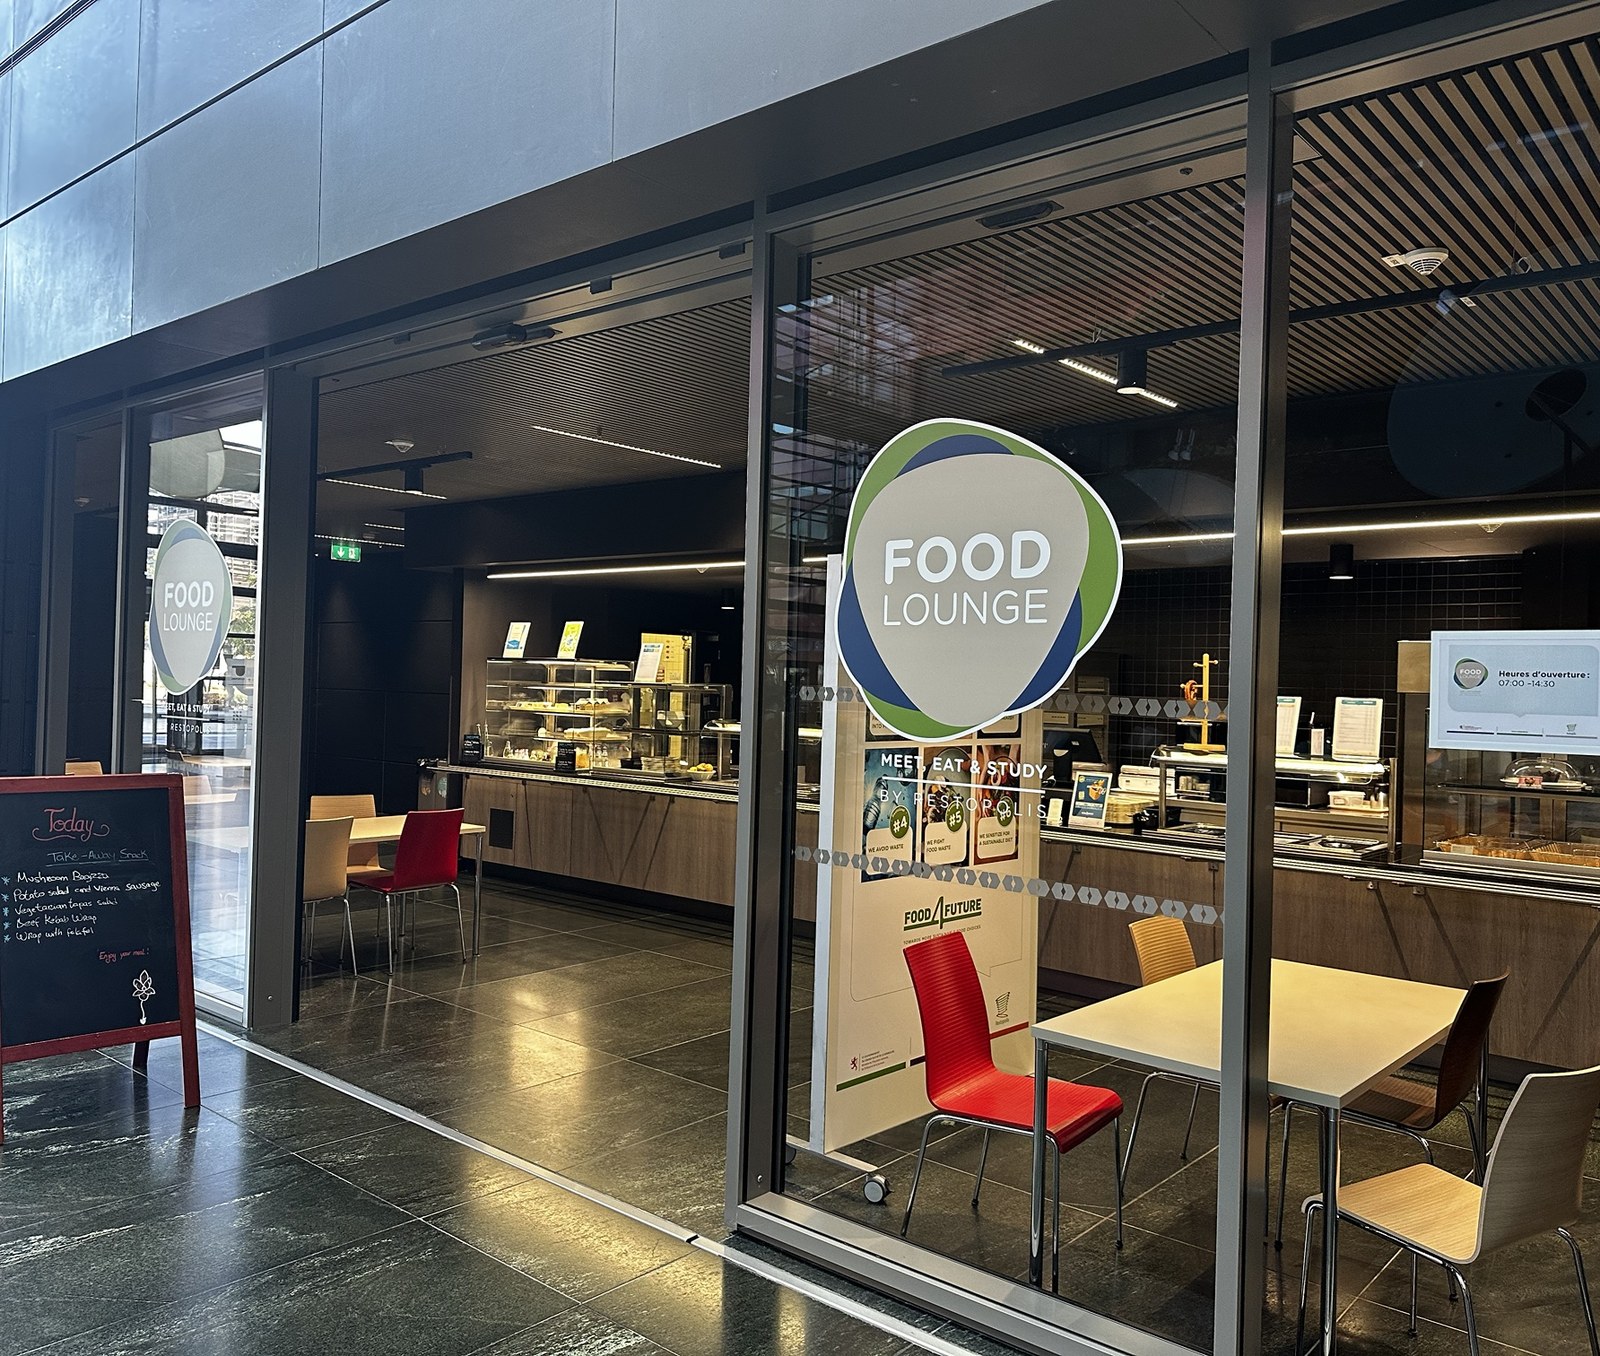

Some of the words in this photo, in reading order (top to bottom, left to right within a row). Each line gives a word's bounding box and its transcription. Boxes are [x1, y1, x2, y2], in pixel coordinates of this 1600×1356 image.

[884, 530, 1051, 585] FOOD
[164, 581, 214, 608] FOOD
[883, 589, 1049, 626] LOUNGE
[163, 612, 213, 631] LOUNGE
[176, 703, 187, 712] EAT
[188, 704, 192, 712] &
[881, 753, 926, 773] MEET,
[932, 757, 964, 773] EAT
[970, 760, 980, 775] &
[987, 760, 1047, 779] STUDY
[880, 789, 902, 803] BY
[913, 792, 1048, 819] RESTOPOLIS
[44, 807, 94, 842] Today
[893, 815, 908, 833] #4
[949, 811, 962, 828] #5
[120, 848, 149, 860] Snack
[17, 871, 69, 883] Mushroom
[13, 888, 45, 902] Potato
[47, 886, 70, 897] salad
[74, 885, 92, 893] and
[14, 903, 67, 917] Vegetarian
[68, 898, 92, 910] tapas
[16, 917, 40, 928] Beef
[44, 914, 70, 924] Kebab
[45, 927, 63, 938] with
[98, 951, 117, 964] Enjoy
[120, 951, 132, 960] your
